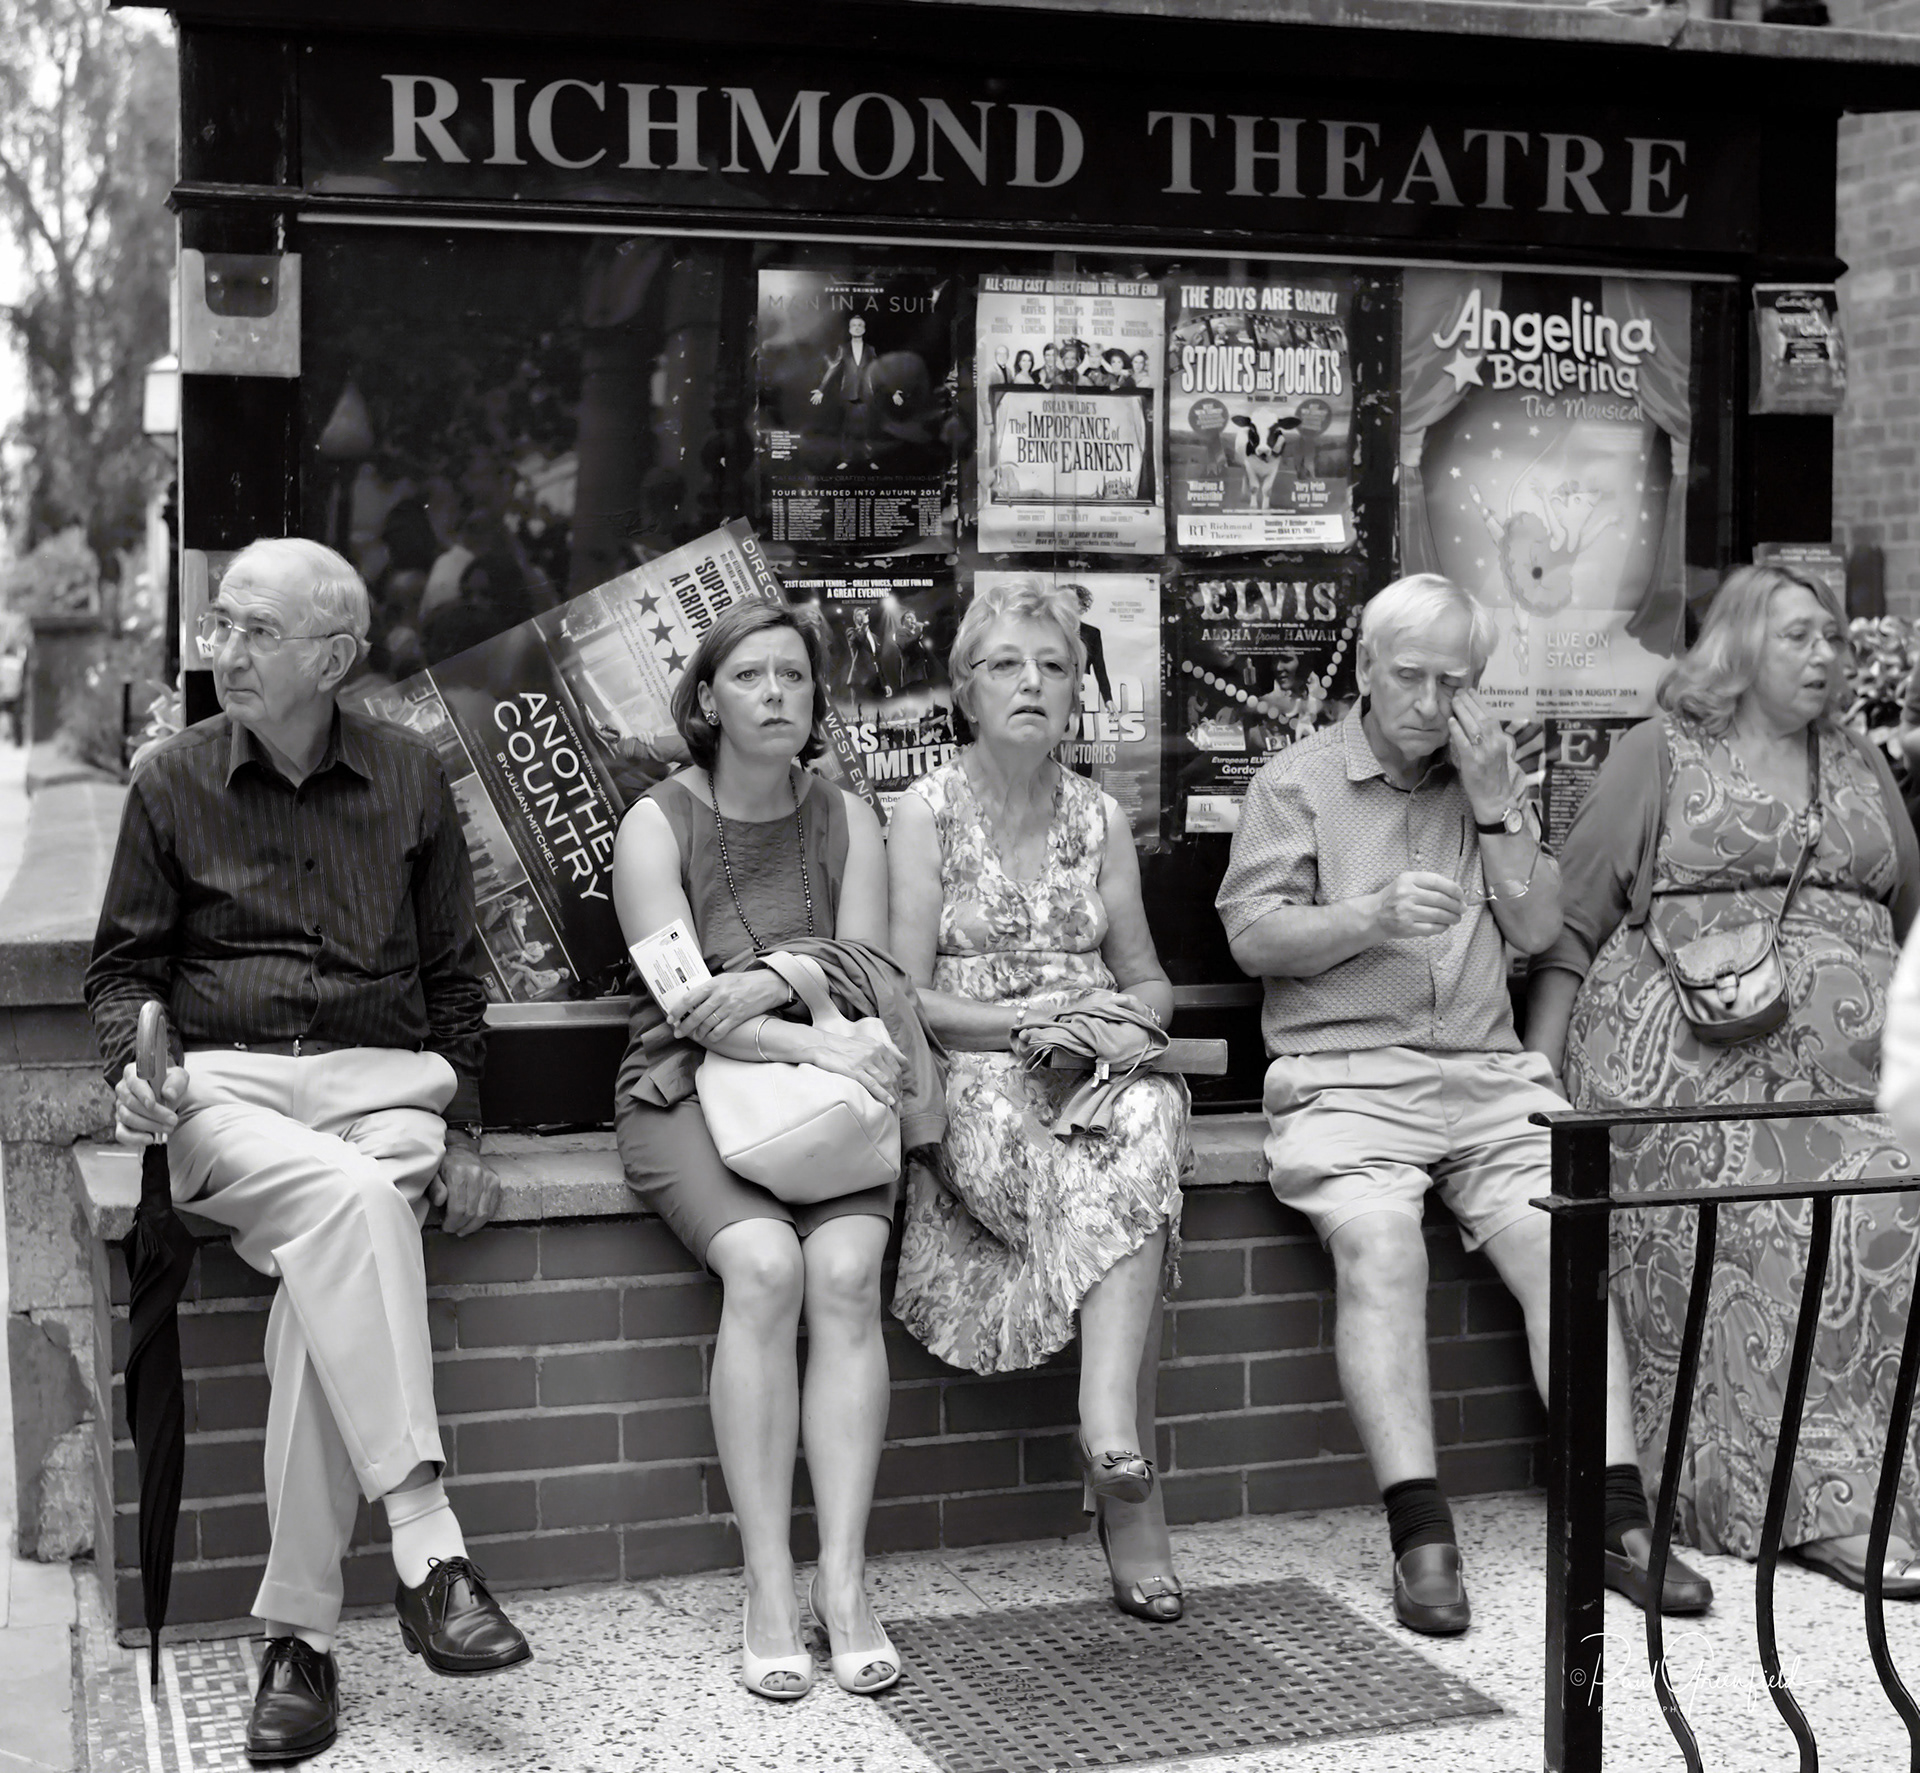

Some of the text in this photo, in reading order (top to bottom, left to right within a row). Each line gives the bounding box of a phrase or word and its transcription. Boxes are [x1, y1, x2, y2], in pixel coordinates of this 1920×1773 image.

[380, 73, 1689, 218] RICHMOND THEATRE
[985, 278, 1022, 292] ALL-STAR
[1025, 279, 1044, 293] CAST
[1077, 282, 1098, 294] FROM
[1101, 283, 1117, 295] THE
[1118, 284, 1140, 295] WEST
[1142, 284, 1159, 296] END
[831, 295, 853, 312] IN
[865, 295, 879, 312] A
[889, 297, 936, 313] SUIT
[1181, 286, 1338, 315] THE BOYS ARE BACK!
[1432, 288, 1655, 364] Angelina
[1181, 345, 1342, 395] STONES IN HIS POCKETS
[1486, 352, 1639, 398] Ballerina
[1043, 400, 1096, 414] OSCAR WILDE'S
[1520, 395, 1645, 422] The Mousical
[1009, 418, 1027, 435] The
[1112, 426, 1120, 440] of
[1017, 437, 1133, 473] BEING EARNEST
[1189, 525, 1206, 537] RT
[1210, 522, 1252, 531] Richmond
[1210, 532, 1242, 540] Theatre
[669, 572, 691, 588] A
[800, 580, 824, 588] CENTURY
[825, 580, 846, 588] TENORS
[853, 579, 870, 587] GREAT
[893, 579, 909, 587] GREAT
[827, 588, 832, 598] A
[833, 588, 856, 598] GREAT
[1198, 582, 1337, 622] ELVIS
[1201, 628, 1337, 644] ALOHA from HAWAII
[1546, 632, 1609, 649] LIVE ON
[1546, 652, 1596, 668] STAGE
[742, 539, 874, 807] DIRECT WEST END
[1479, 686, 1529, 696] ichmond
[1559, 689, 1572, 697] SUN
[1585, 689, 1617, 697] AUGUST
[1556, 720, 1581, 729] The
[556, 706, 583, 750] CHICHESTER
[579, 749, 599, 783] FESTIVAL
[596, 782, 615, 816] THEATRE
[1061, 744, 1116, 764] VICTORIES
[1211, 756, 1249, 764] European
[519, 692, 614, 873] ANOTHE
[494, 700, 609, 901] COUNTRY
[496, 752, 558, 876] BY JULIAN MITCHELL
